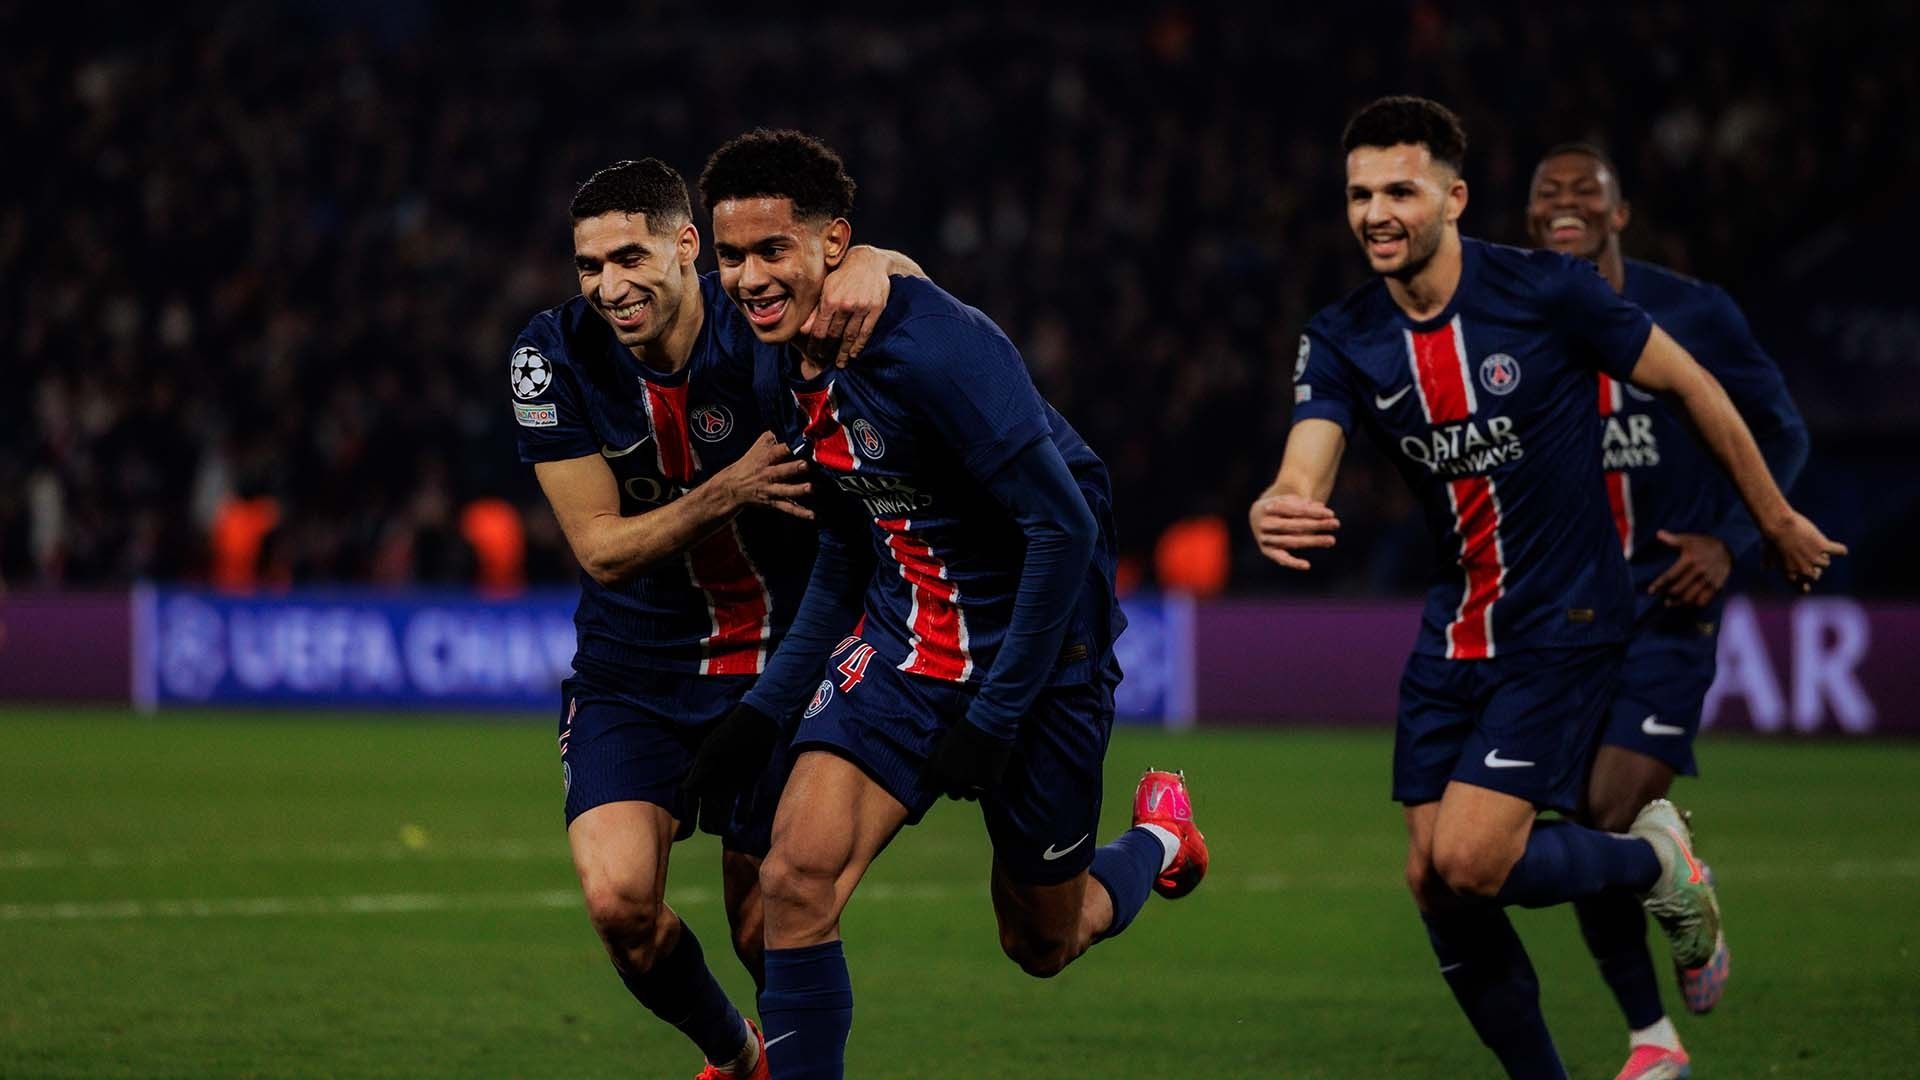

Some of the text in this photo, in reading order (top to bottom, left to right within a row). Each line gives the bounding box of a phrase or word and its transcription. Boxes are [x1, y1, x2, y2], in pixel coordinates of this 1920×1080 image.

[1399, 415, 1520, 473] QATAR
[1601, 413, 1658, 447] AR
[229, 607, 403, 693] UEFA
